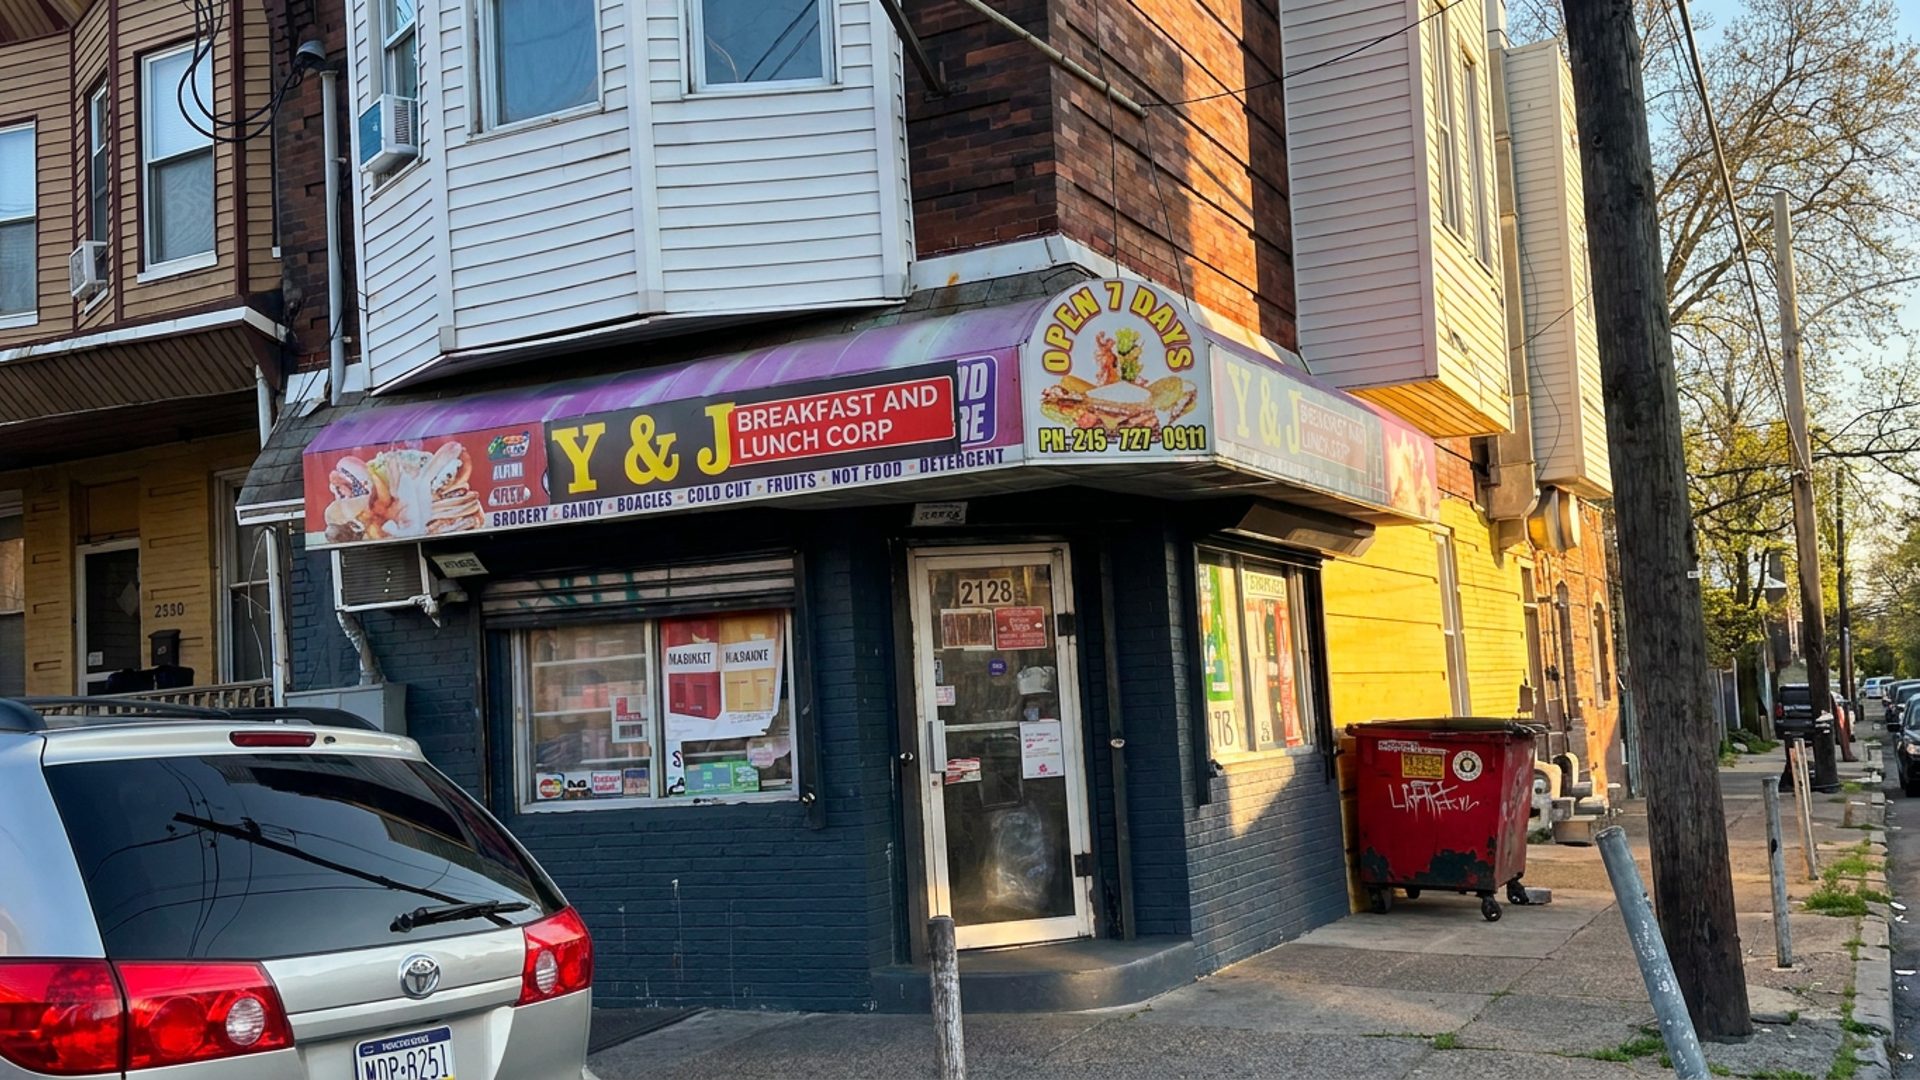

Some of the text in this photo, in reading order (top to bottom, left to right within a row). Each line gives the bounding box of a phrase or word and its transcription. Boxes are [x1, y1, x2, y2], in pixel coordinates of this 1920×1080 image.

[1042, 280, 1195, 376] OPEN 7 DAYS
[737, 385, 938, 433] BREAKFAST AND
[739, 419, 893, 459] LUNCH CORP
[1226, 361, 1251, 439] Y
[1259, 376, 1281, 448] &
[1286, 389, 1302, 455] J
[551, 402, 736, 494] Y & J
[617, 491, 672, 512] BOAGLES
[687, 485, 720, 503] COLD
[725, 481, 752, 498] CUT
[767, 473, 816, 493] FRUITS
[865, 461, 902, 481] FOOD
[920, 448, 1004, 473] DETERGENT
[961, 579, 1012, 605] 2128
